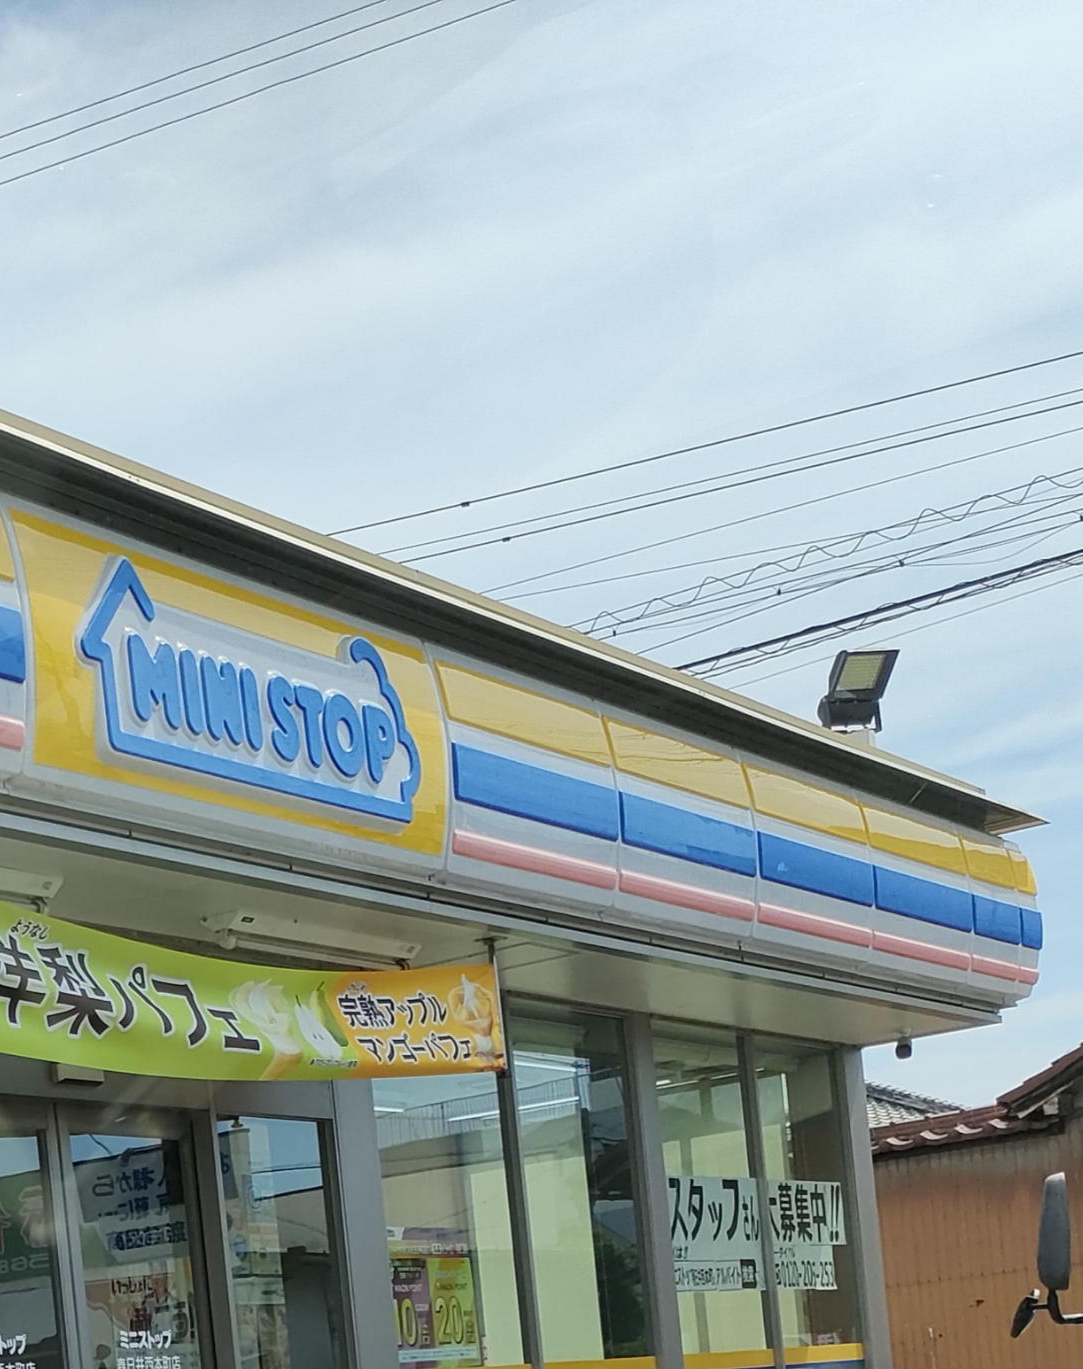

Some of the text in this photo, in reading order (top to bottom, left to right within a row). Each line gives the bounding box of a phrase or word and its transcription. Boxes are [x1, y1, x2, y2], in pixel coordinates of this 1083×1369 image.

[127, 632, 396, 785] MINI STOP
[338, 991, 447, 1029] 完熟アップル
[357, 1032, 472, 1063] マンゴーパフェ
[119, 1329, 172, 1350] ミニストップ
